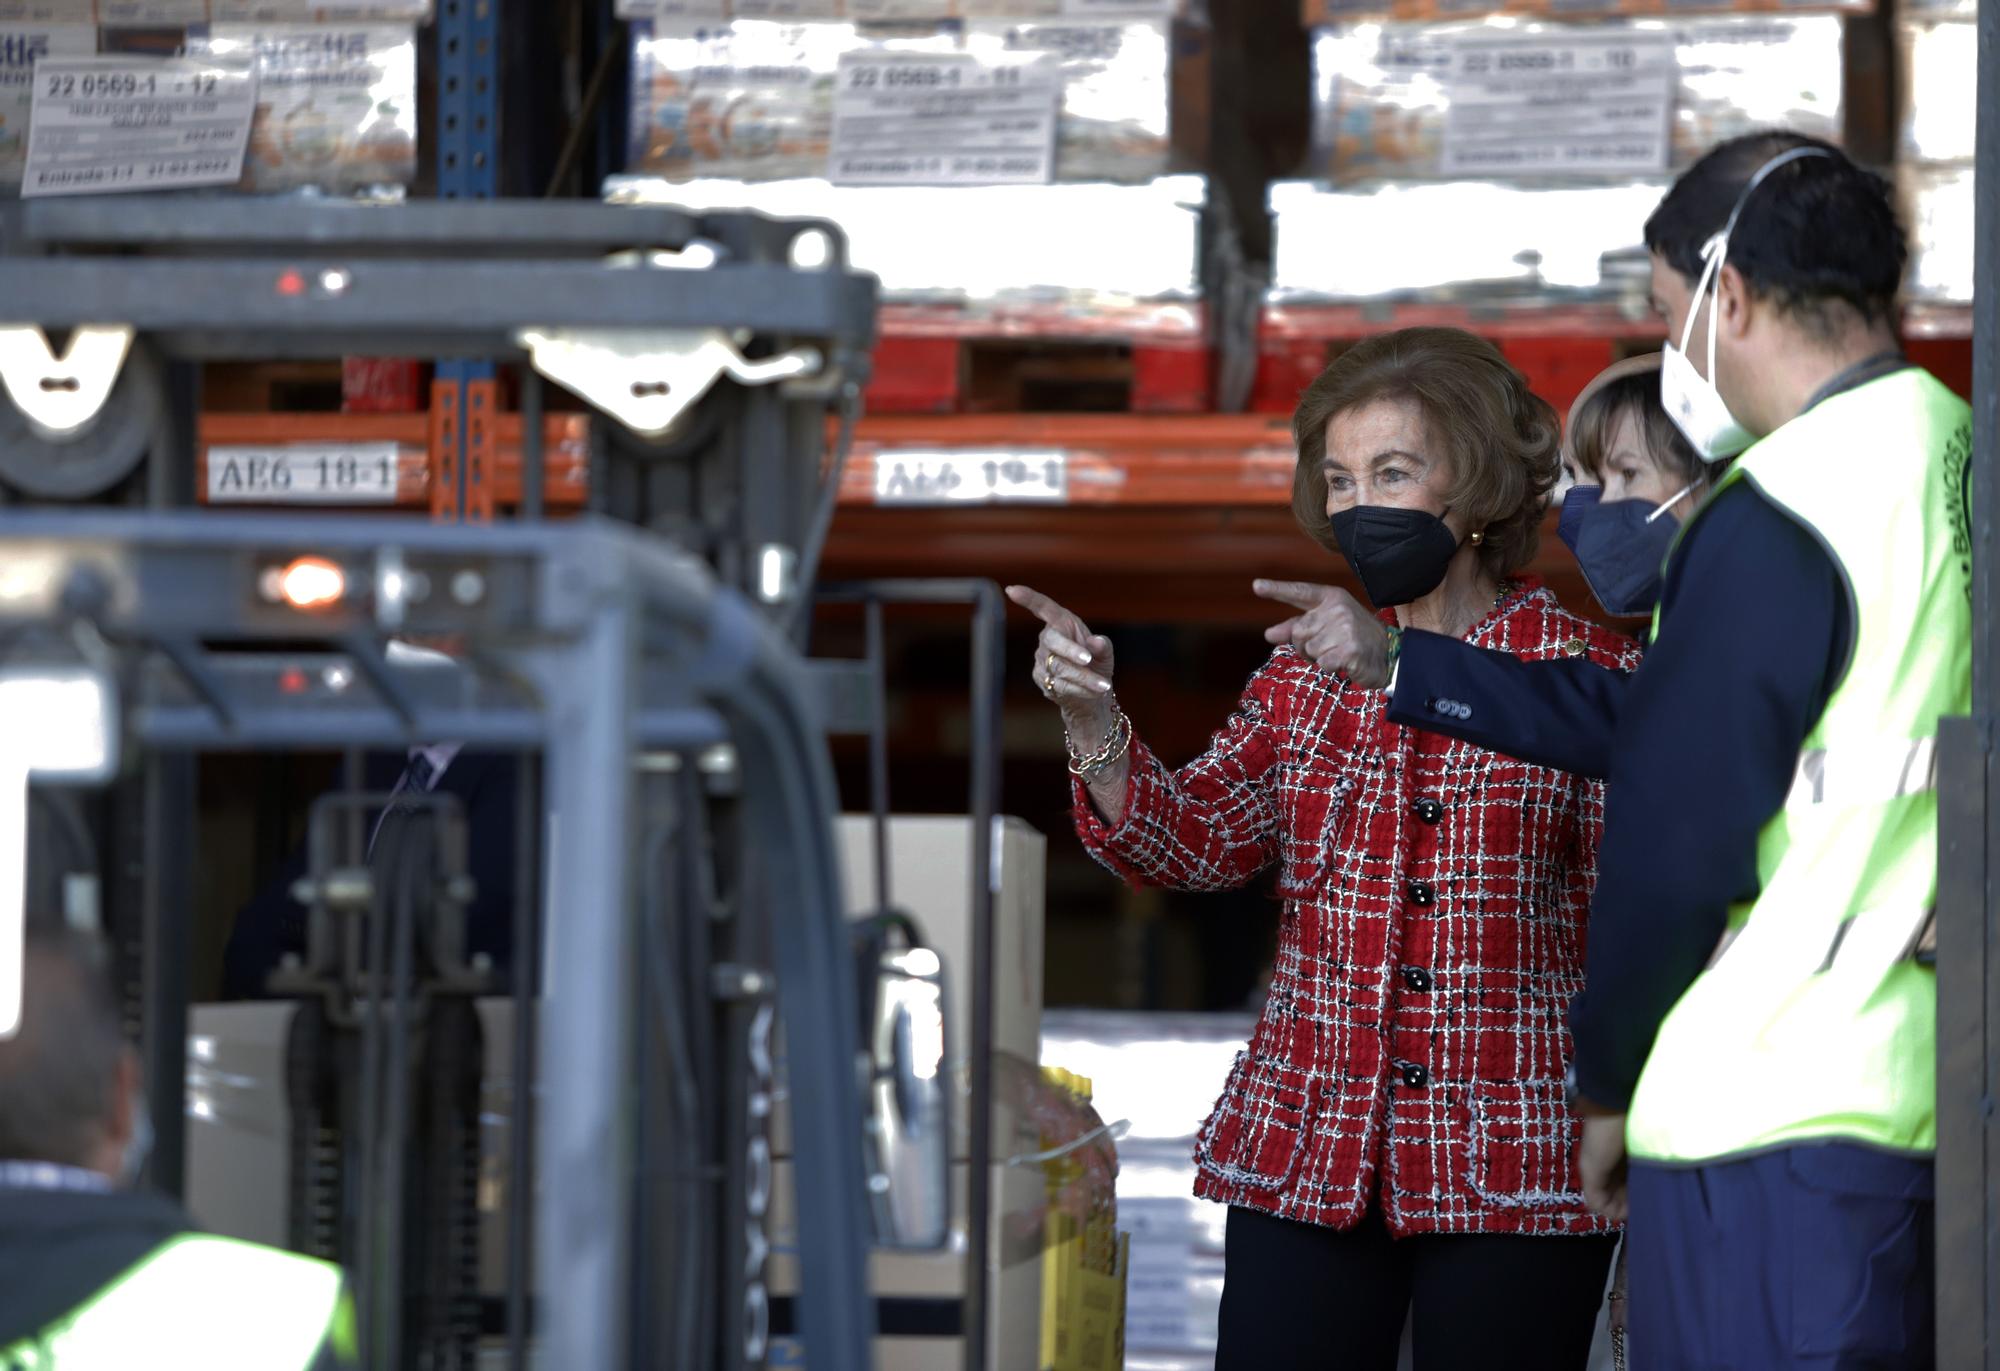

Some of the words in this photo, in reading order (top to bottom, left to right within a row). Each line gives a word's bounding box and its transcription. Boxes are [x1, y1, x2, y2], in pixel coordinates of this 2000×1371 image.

[48, 74, 75, 97] 22
[81, 73, 156, 97] 0569-1
[191, 74, 218, 97] 12
